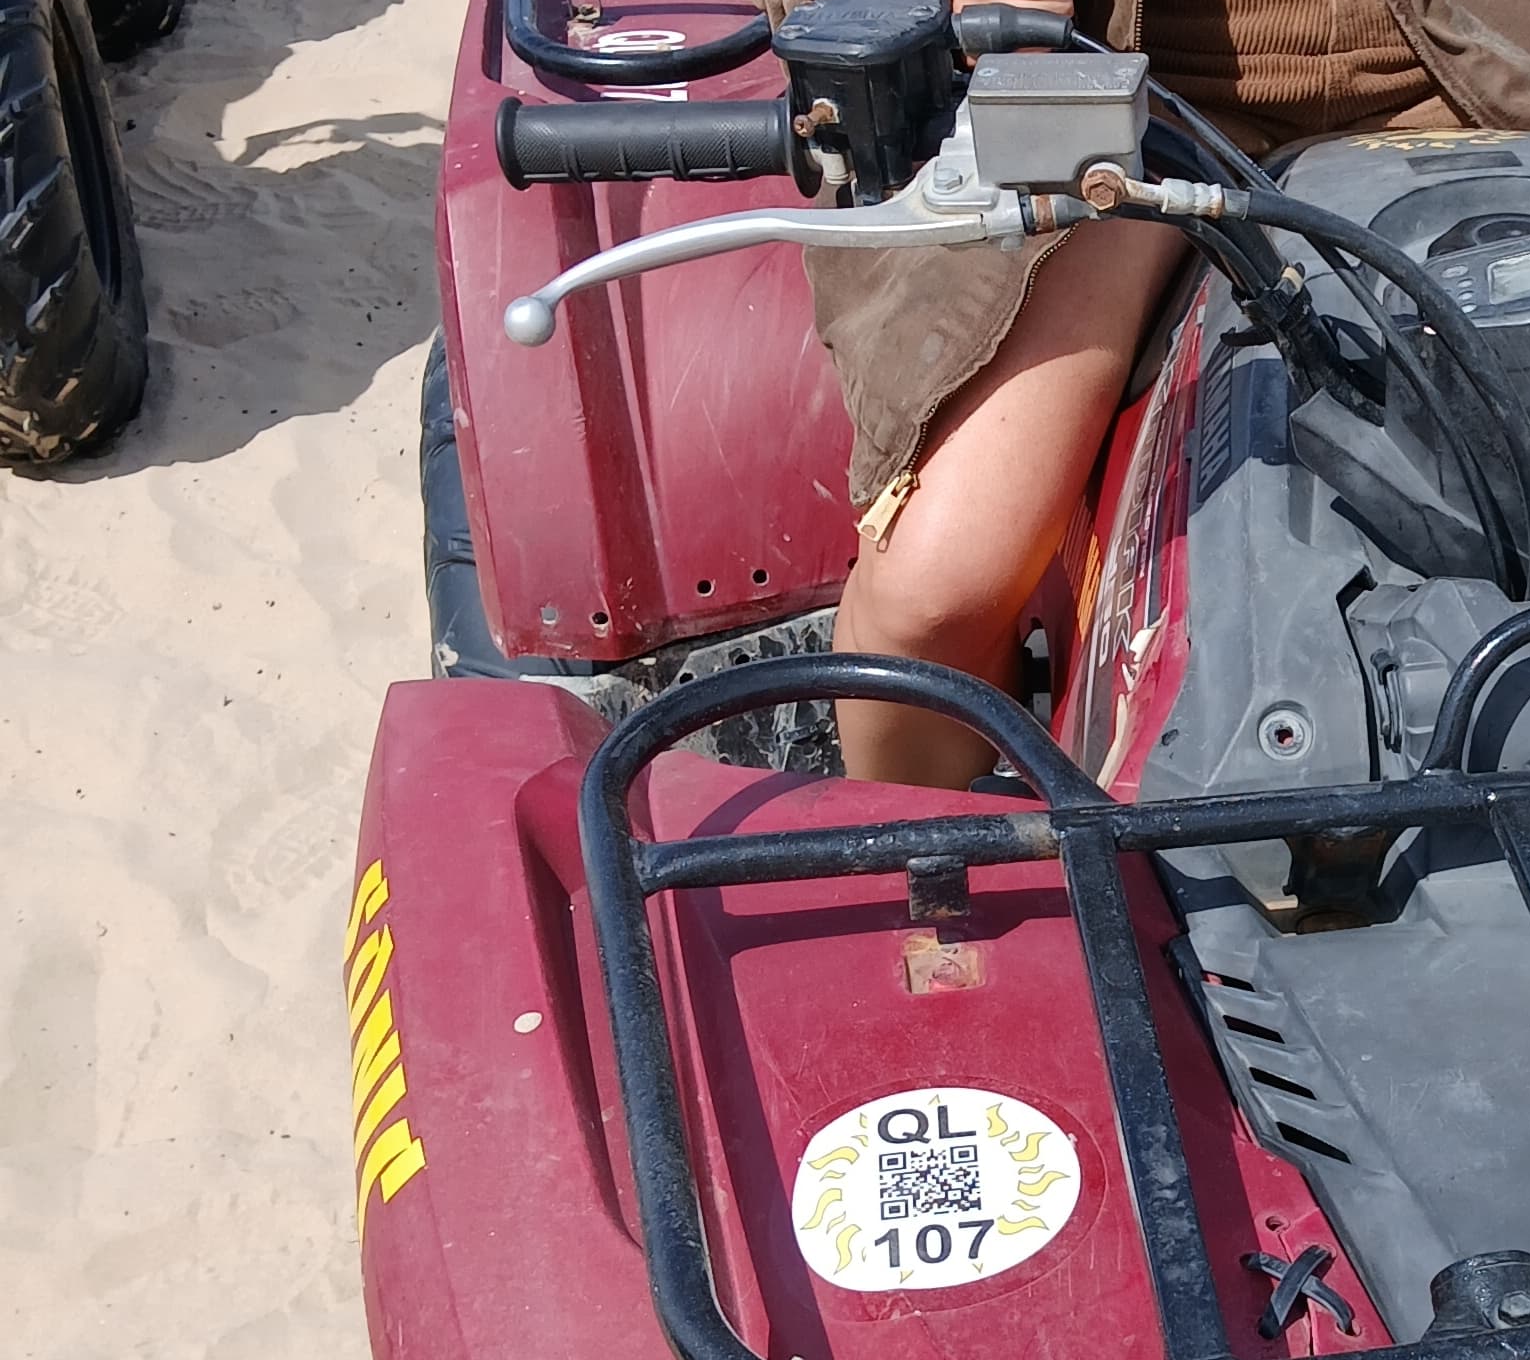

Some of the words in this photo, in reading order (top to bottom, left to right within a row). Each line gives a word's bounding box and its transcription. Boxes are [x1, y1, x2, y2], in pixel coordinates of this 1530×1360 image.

[1197, 344, 1233, 493] YAMAHA
[877, 1104, 977, 1145] QL
[874, 1218, 995, 1269] 107
